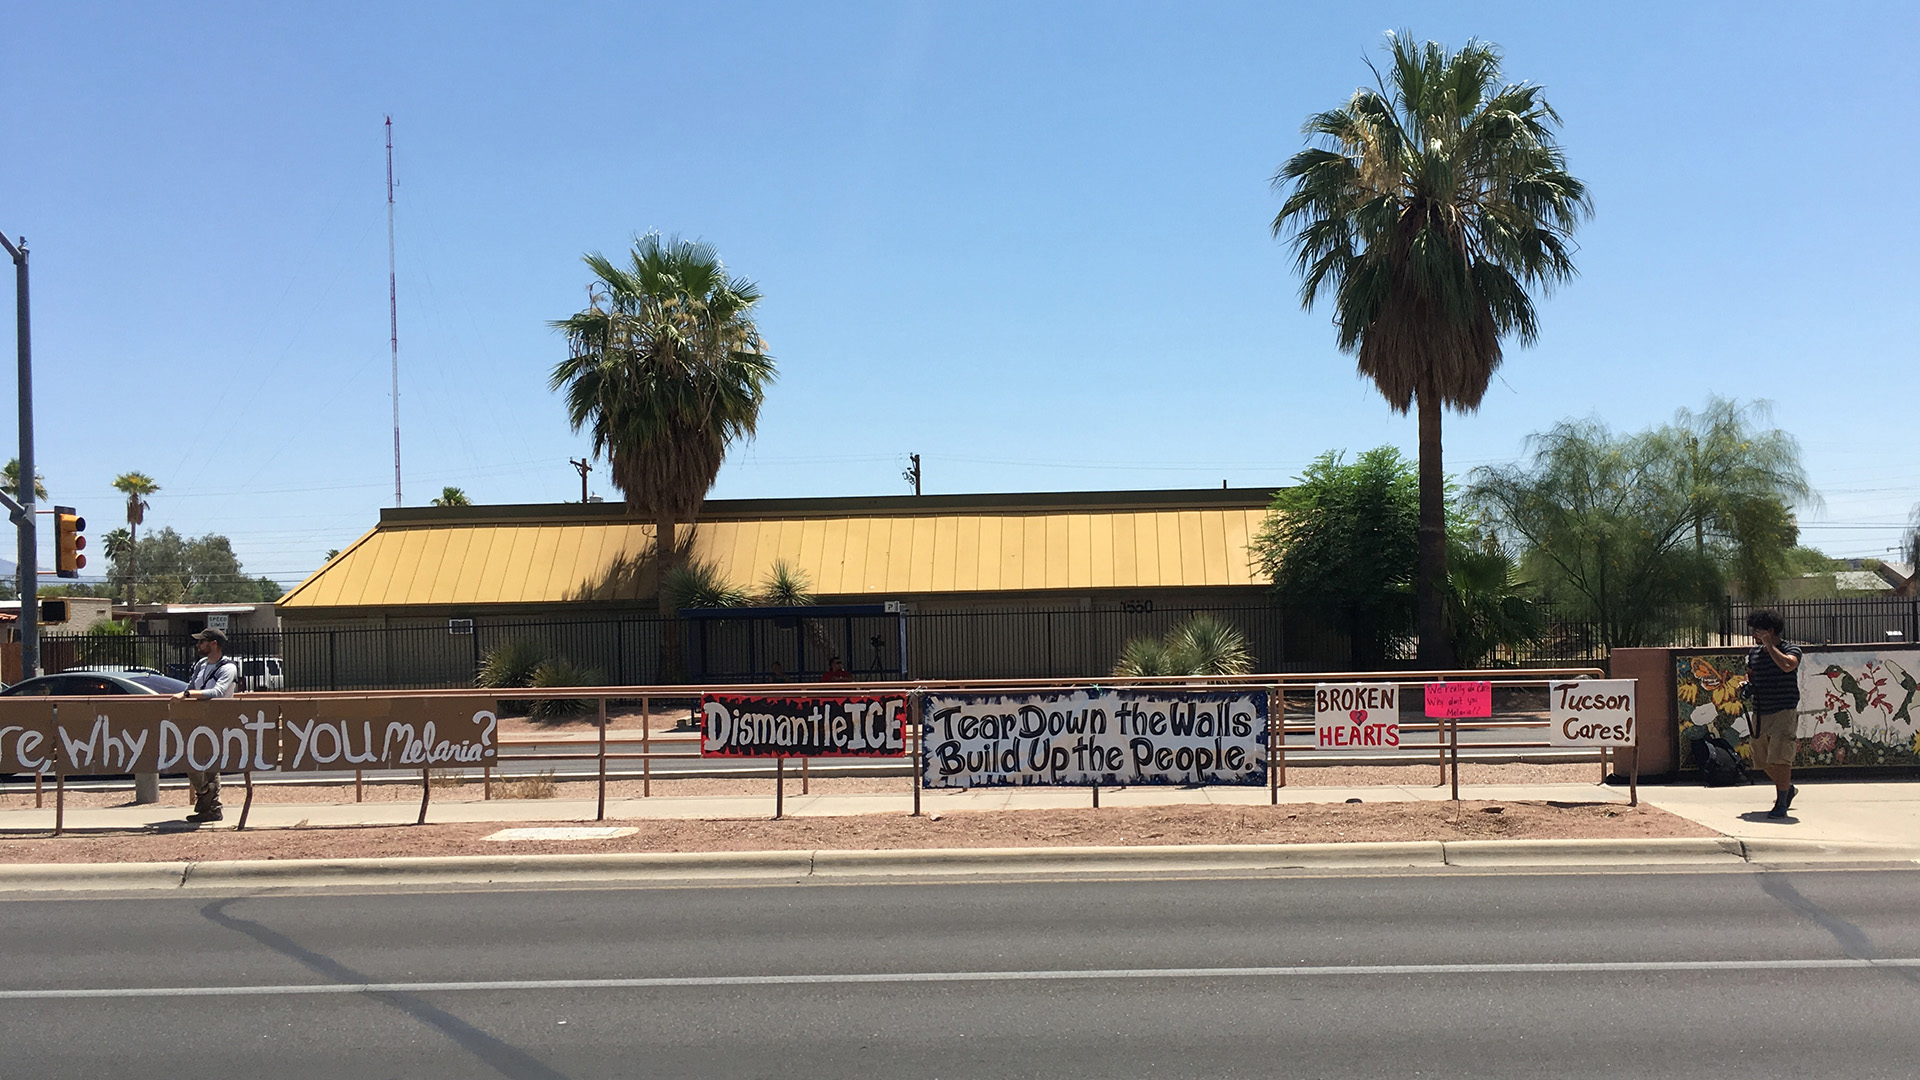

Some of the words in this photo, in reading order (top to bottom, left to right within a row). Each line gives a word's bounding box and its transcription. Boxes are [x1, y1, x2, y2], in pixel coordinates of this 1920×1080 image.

[1316, 687, 1395, 712] BROKEN
[1553, 683, 1631, 712] Tucson
[703, 701, 847, 751] Dismantle
[844, 700, 904, 750] ICE
[933, 705, 1017, 740] Tear
[1017, 705, 1107, 738] Down
[1114, 702, 1167, 736] the
[1169, 702, 1252, 737] Walls
[1319, 723, 1400, 747] HEARTS
[1562, 717, 1633, 742] Cares!
[57, 714, 149, 773] Why
[381, 710, 497, 764] Melania?
[935, 739, 1022, 775] Build
[1027, 737, 1070, 783] Up
[1072, 734, 1124, 771] the
[1129, 736, 1254, 782] People.
